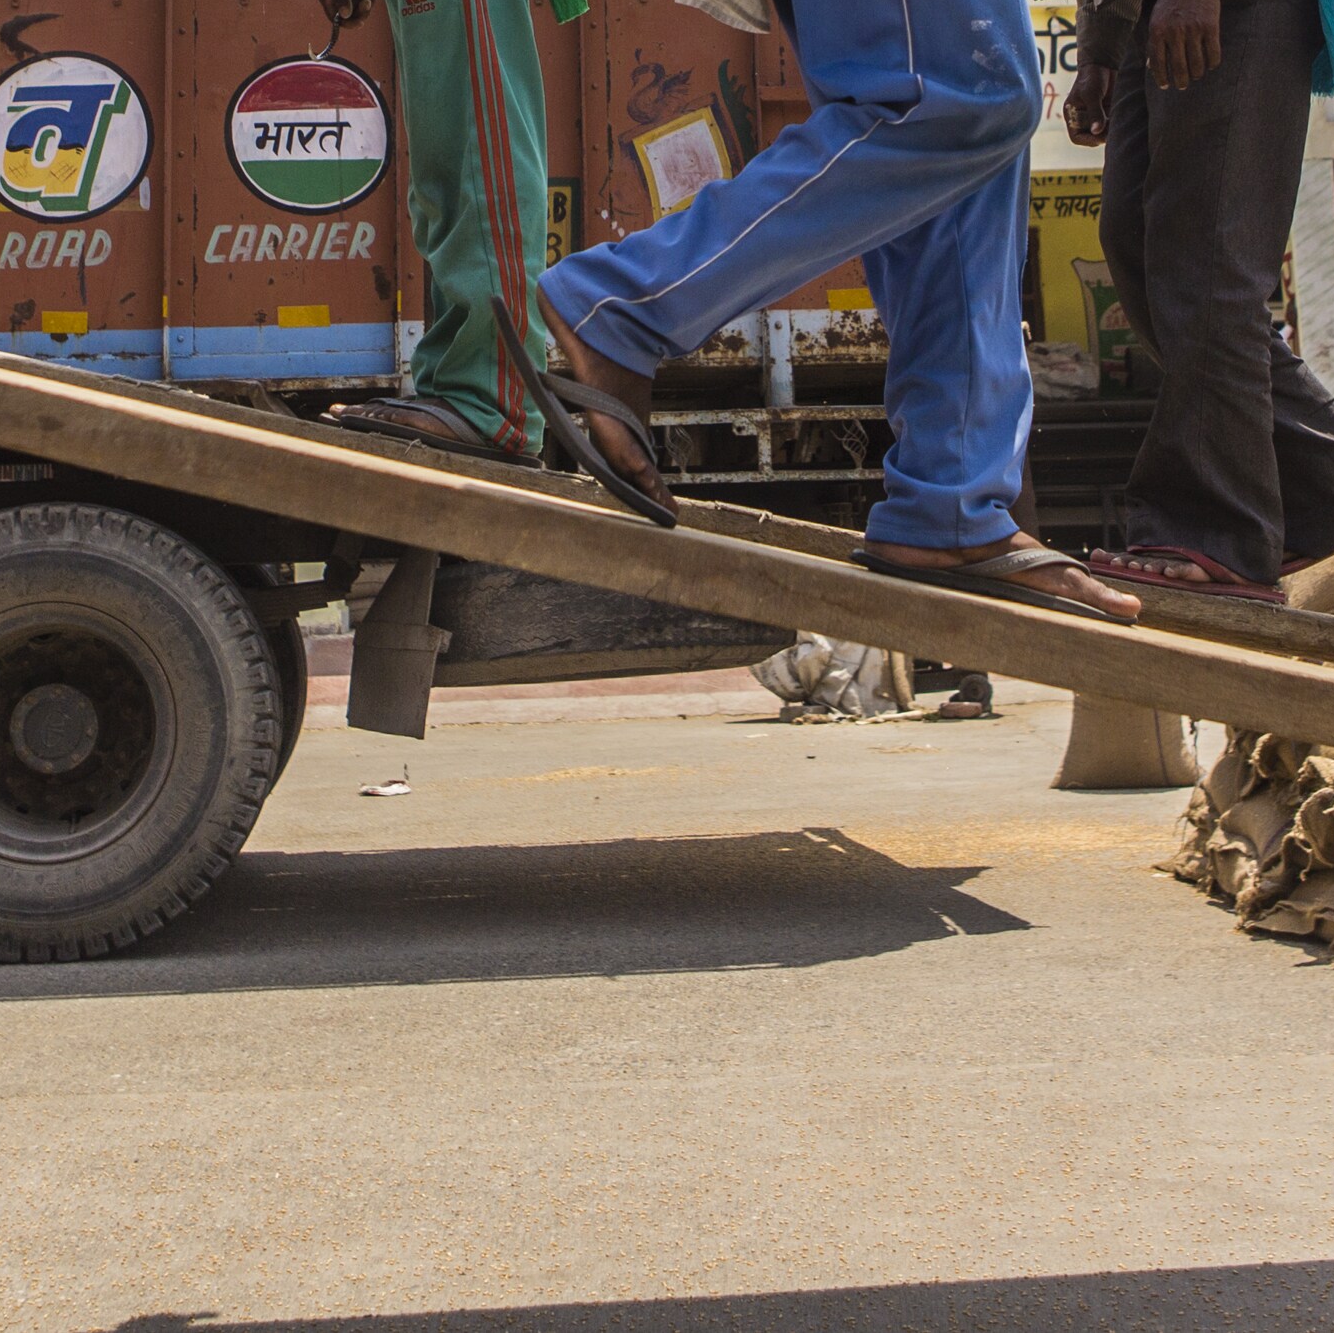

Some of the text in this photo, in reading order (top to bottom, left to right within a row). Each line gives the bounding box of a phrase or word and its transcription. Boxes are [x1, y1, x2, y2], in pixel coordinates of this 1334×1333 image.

[402, 1, 436, 17] adidas
[254, 121, 352, 156] भारत
[204, 221, 377, 264] CARRIER
